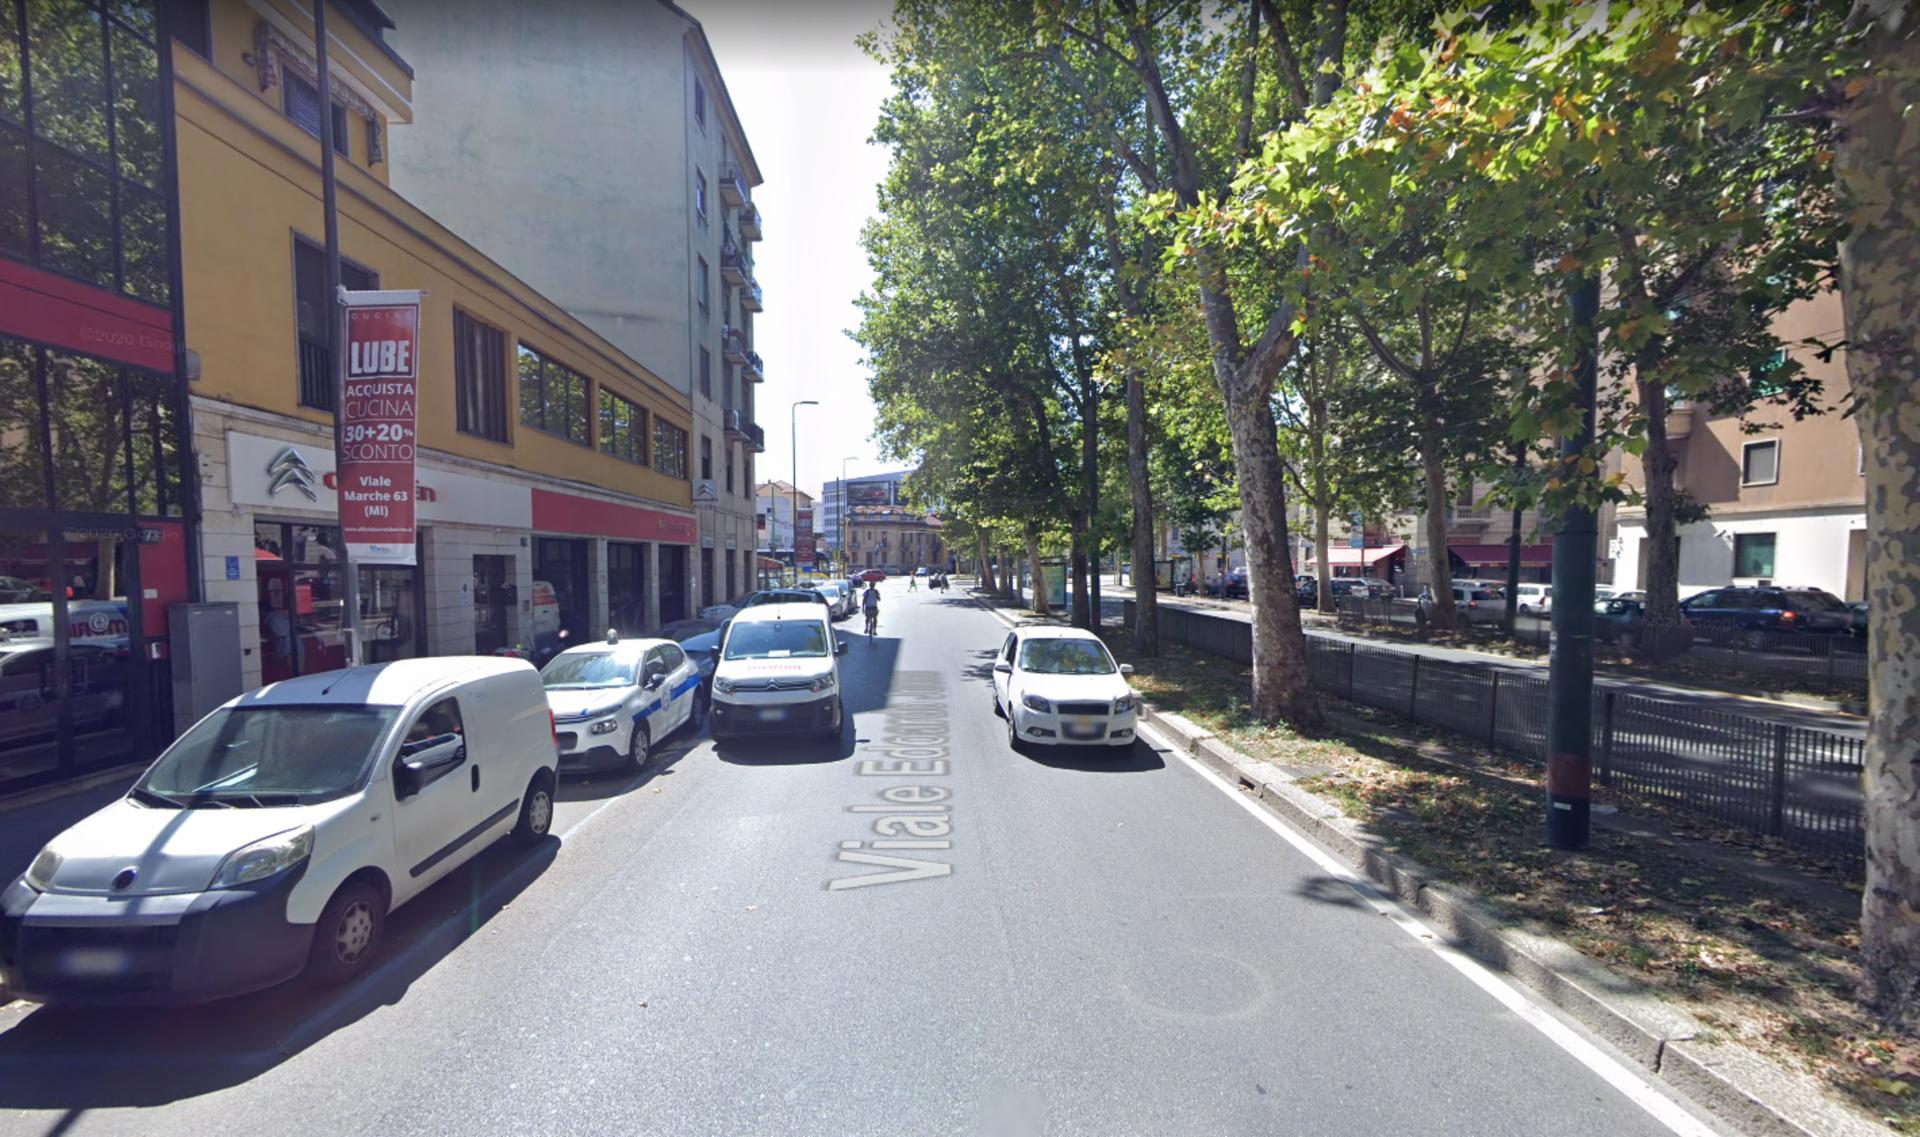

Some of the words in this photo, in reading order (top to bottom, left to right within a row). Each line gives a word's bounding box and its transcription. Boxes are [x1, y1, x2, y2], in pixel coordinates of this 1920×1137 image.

[351, 340, 410, 374] LUBE
[346, 383, 414, 398] ACQUISTA
[346, 400, 414, 419] CUCINA
[343, 444, 413, 460] SCONTO
[360, 476, 391, 487] Viale
[344, 491, 391, 501] Marche
[393, 491, 408, 501] 63
[364, 505, 389, 517] (MI)
